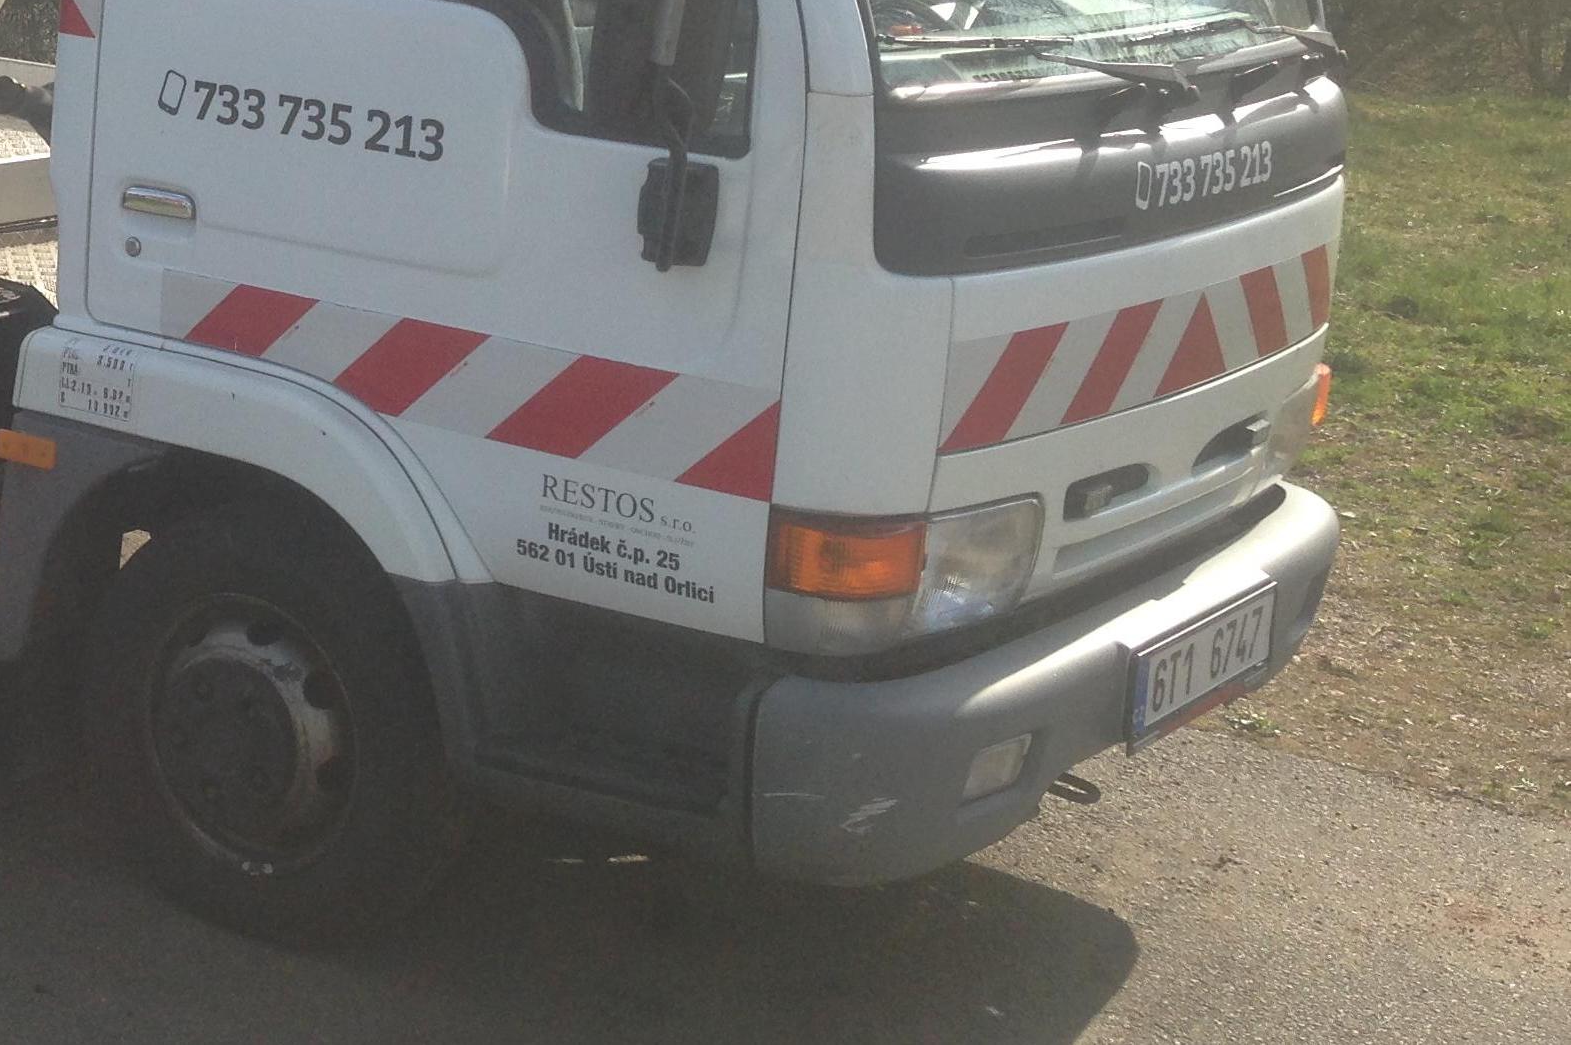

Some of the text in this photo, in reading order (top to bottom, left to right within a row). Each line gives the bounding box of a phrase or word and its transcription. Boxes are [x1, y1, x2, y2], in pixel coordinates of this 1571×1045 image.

[194, 80, 445, 162] 733 735 213
[1155, 140, 1273, 207] 733 735 213
[542, 474, 654, 523] RESTOS
[660, 515, 696, 534] s.r.o.
[516, 538, 550, 563] 562
[554, 548, 576, 569] 01
[624, 569, 659, 590] nad
[547, 521, 611, 554] Hrádek
[616, 539, 650, 566] č.p.
[656, 548, 681, 571] 25
[1152, 605, 1265, 713] 6T1 6747
